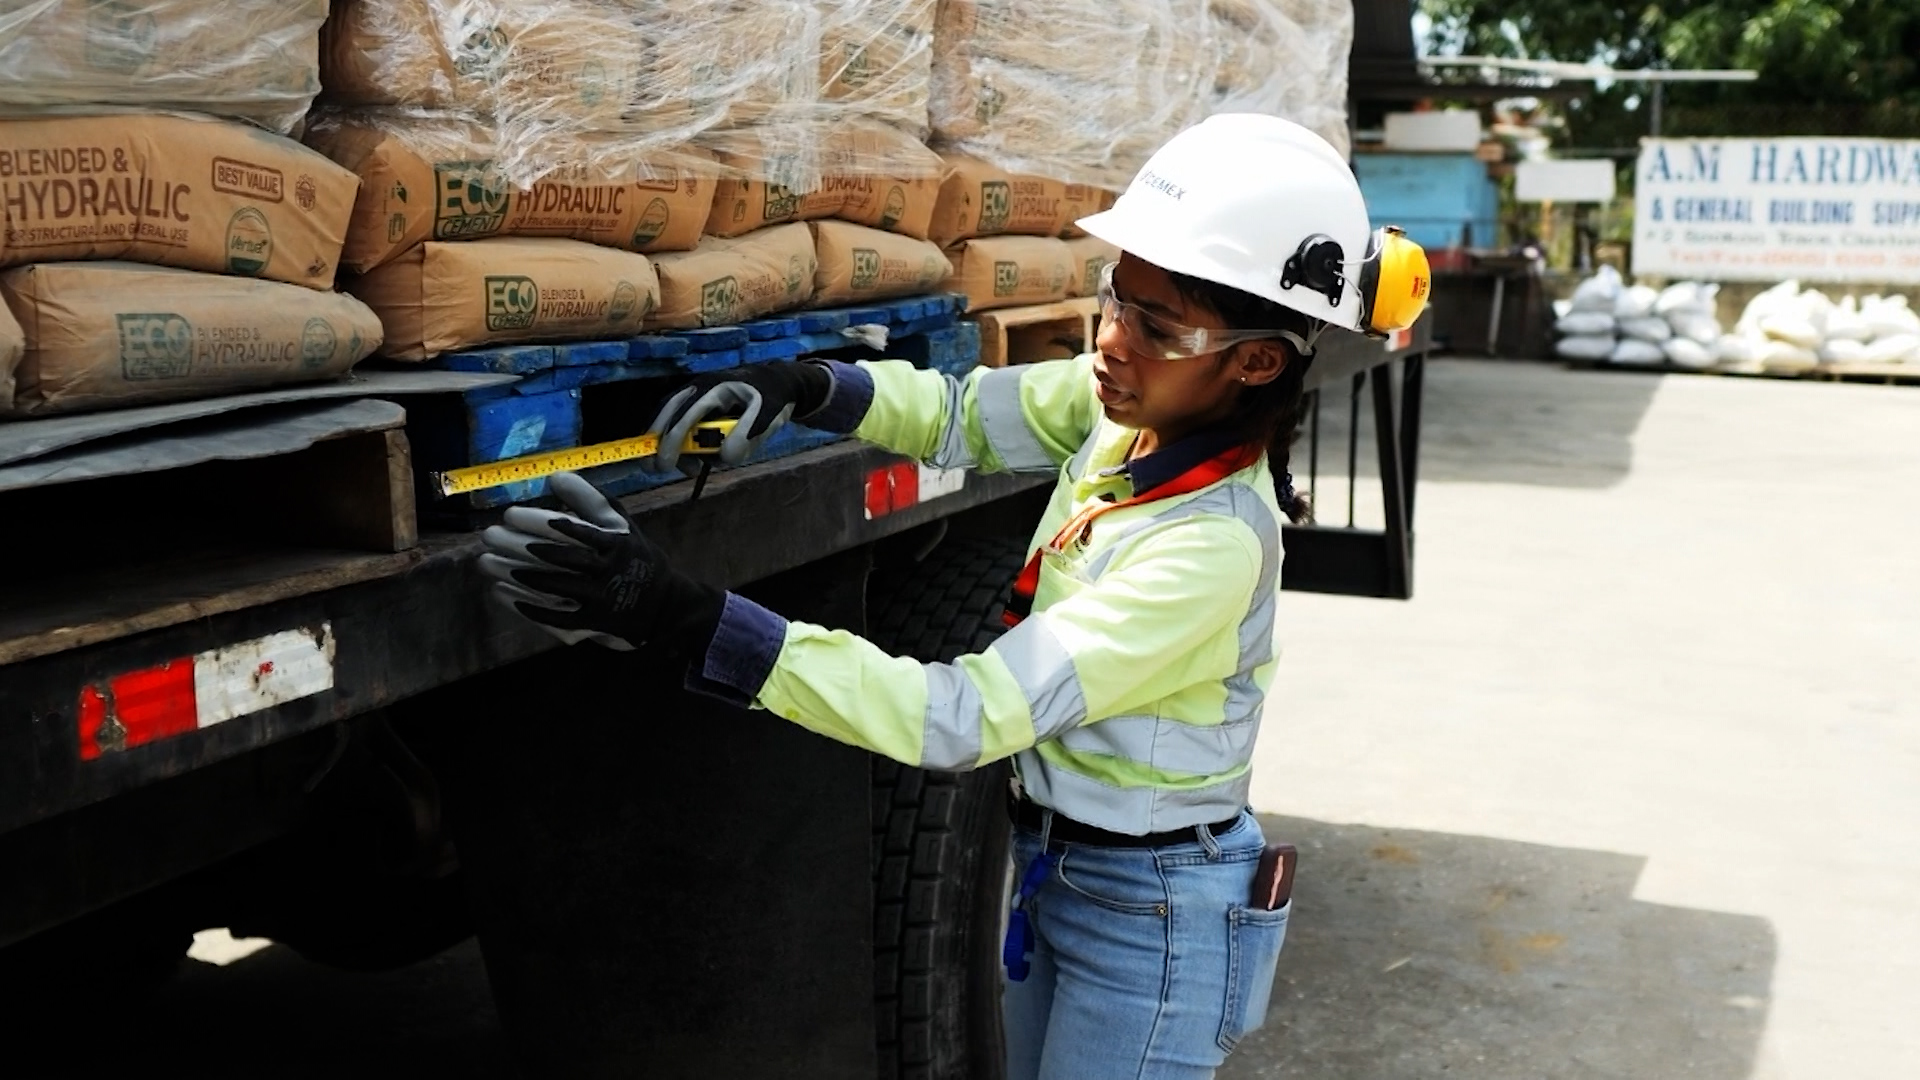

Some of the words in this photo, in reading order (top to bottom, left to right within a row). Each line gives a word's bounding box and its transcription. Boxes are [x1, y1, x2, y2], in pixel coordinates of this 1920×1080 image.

[0, 147, 107, 177] BLENDED
[112, 147, 129, 173] &
[218, 165, 245, 186] BEST
[246, 171, 279, 194] VALUE
[439, 168, 509, 217] ECO
[1145, 172, 1188, 202] CEMEX
[3, 177, 191, 222] HYDRAULIC
[516, 183, 626, 215] HYDRAULIC
[983, 186, 1009, 217] ECO
[1674, 197, 1752, 223] GENERAL
[1769, 198, 1853, 224] BUILDING
[103, 223, 126, 236] AND
[170, 229, 190, 242] USE
[442, 215, 502, 234] CEMENT
[855, 253, 879, 277] ECO
[997, 265, 1018, 285] ECO
[489, 281, 537, 314] ECO
[541, 289, 579, 300] BLENDED
[704, 279, 737, 312] ECO
[540, 301, 608, 318] HYDRAULIC
[122, 318, 188, 359] ECO
[197, 327, 252, 342] BLENDED
[198, 341, 295, 363] HYDRAULIC
